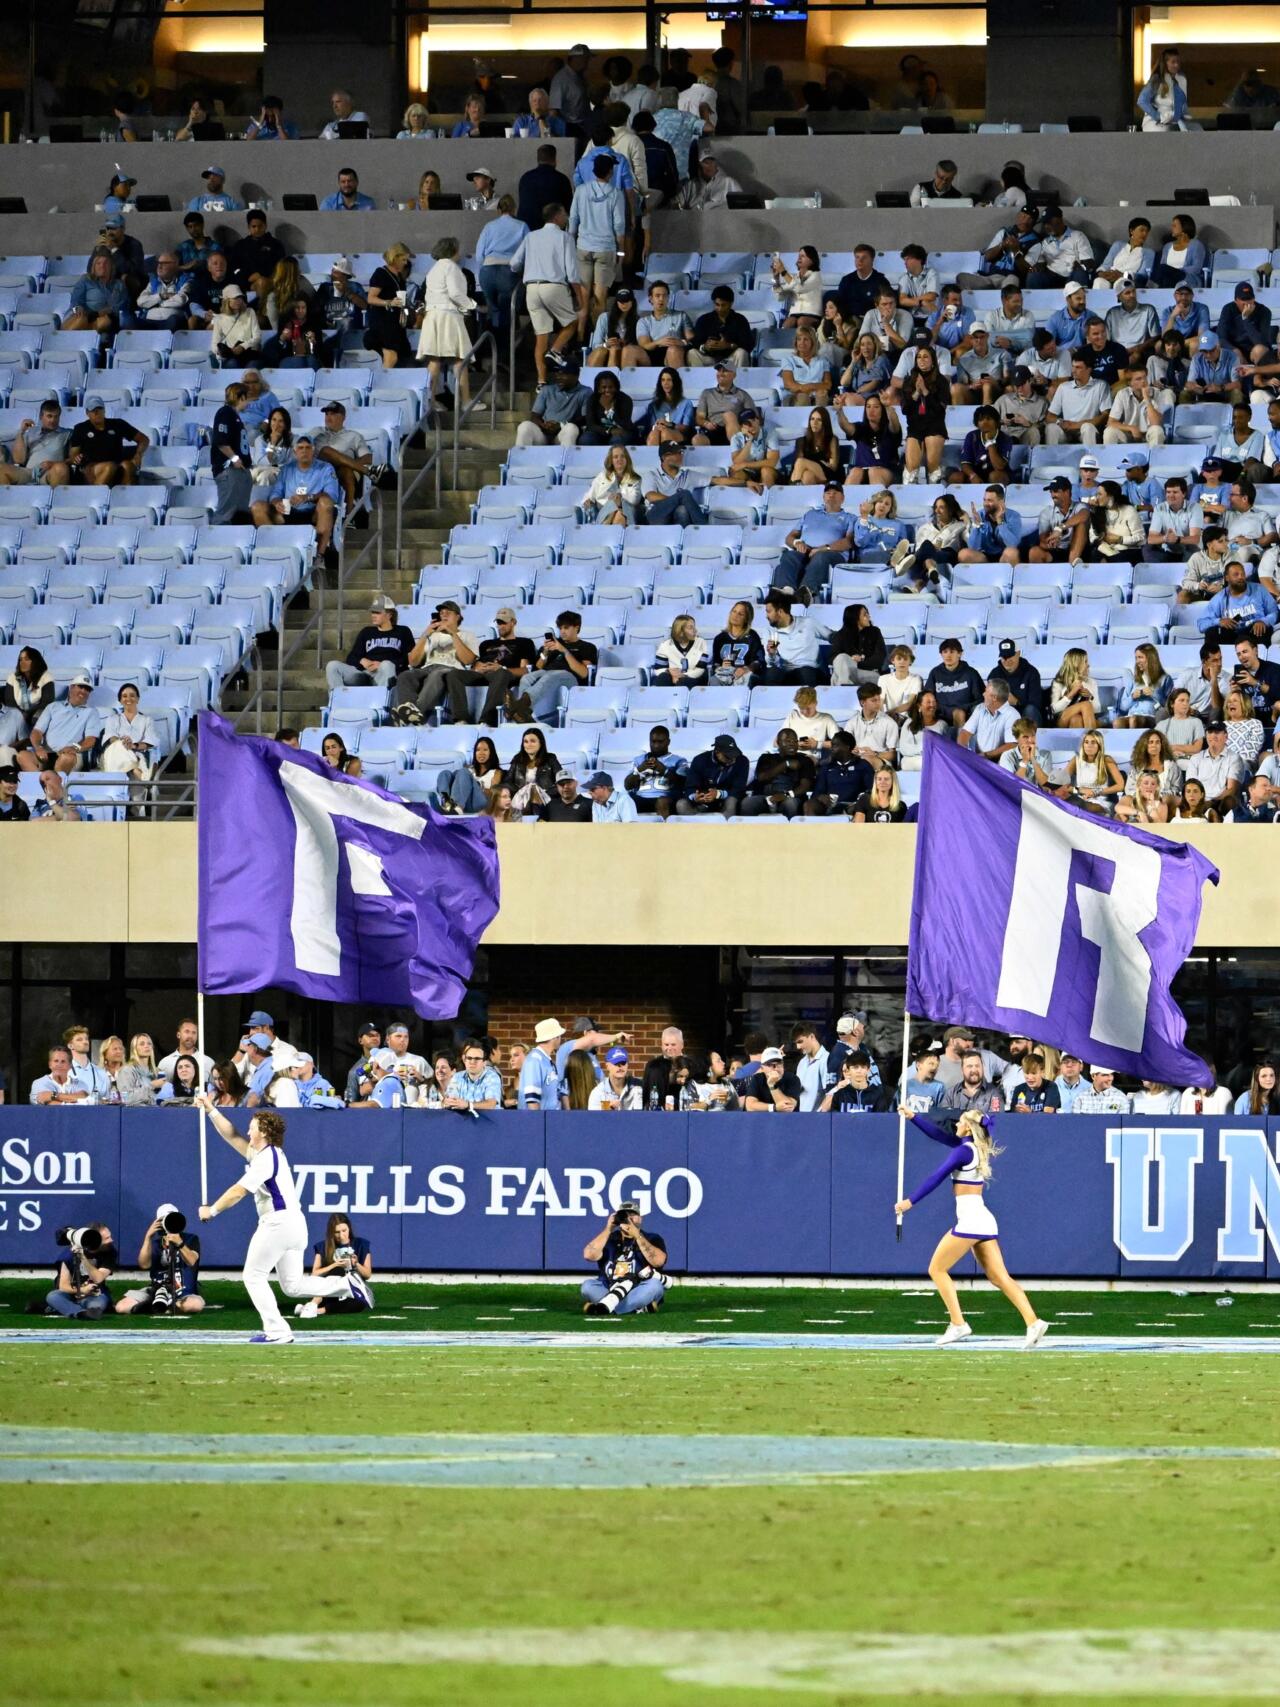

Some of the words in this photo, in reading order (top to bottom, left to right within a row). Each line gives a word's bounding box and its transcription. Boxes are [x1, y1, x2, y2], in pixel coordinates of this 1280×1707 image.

[996, 788, 1162, 1053] R
[1, 1137, 94, 1186] Son
[484, 1165, 704, 1218] FARGO
